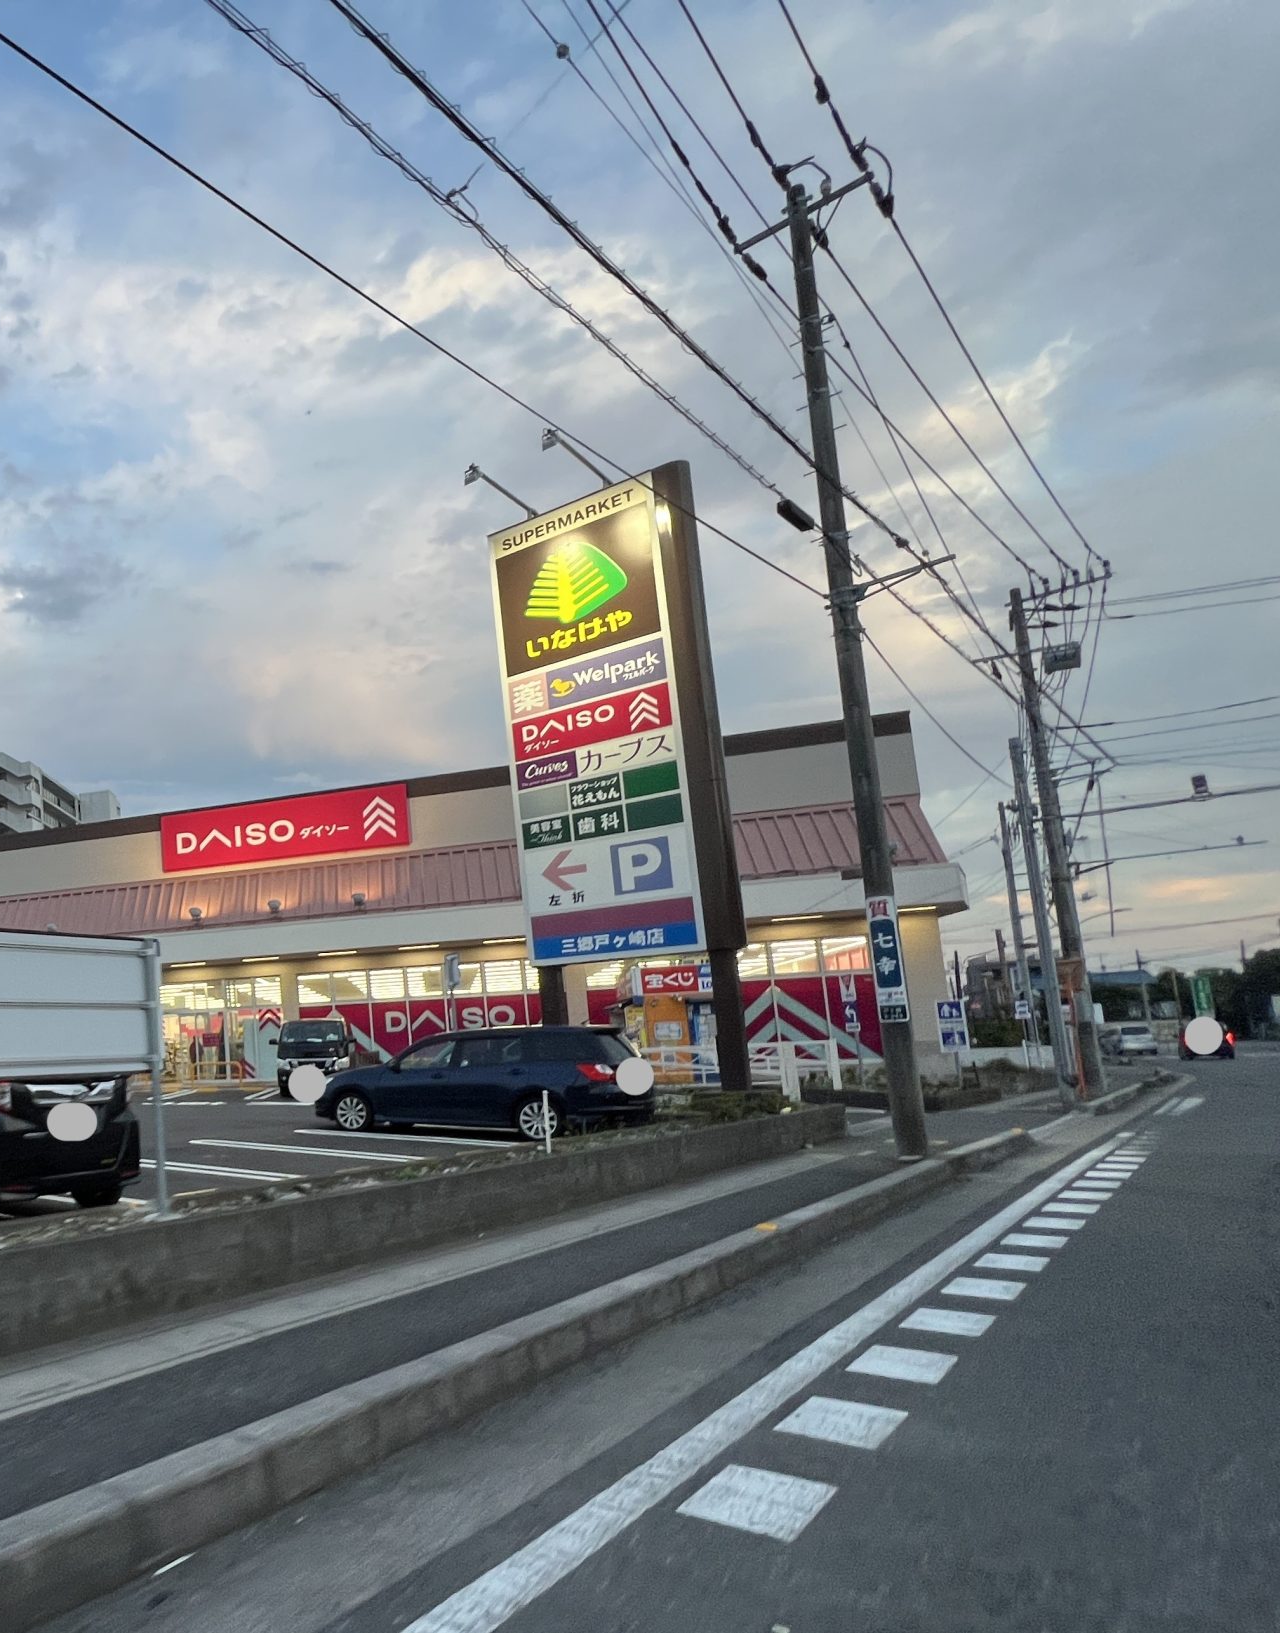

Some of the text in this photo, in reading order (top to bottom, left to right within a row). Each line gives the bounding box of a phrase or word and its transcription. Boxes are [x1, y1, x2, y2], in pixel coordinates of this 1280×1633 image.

[502, 488, 634, 551] SUPERMARKET
[573, 650, 661, 684] Welpark
[512, 679, 544, 714] 薬
[522, 704, 615, 743] DAISO
[524, 739, 560, 754] ダイソー
[579, 734, 673, 774] カーブス
[525, 760, 569, 779] Curves
[571, 787, 620, 808] 花えもん
[176, 819, 350, 854] DAISO ダイソー
[577, 811, 620, 836] 歯科
[618, 843, 662, 892] P
[548, 891, 585, 907] 左折
[644, 972, 695, 989] 宝くじ
[385, 1005, 516, 1033] DAISO
